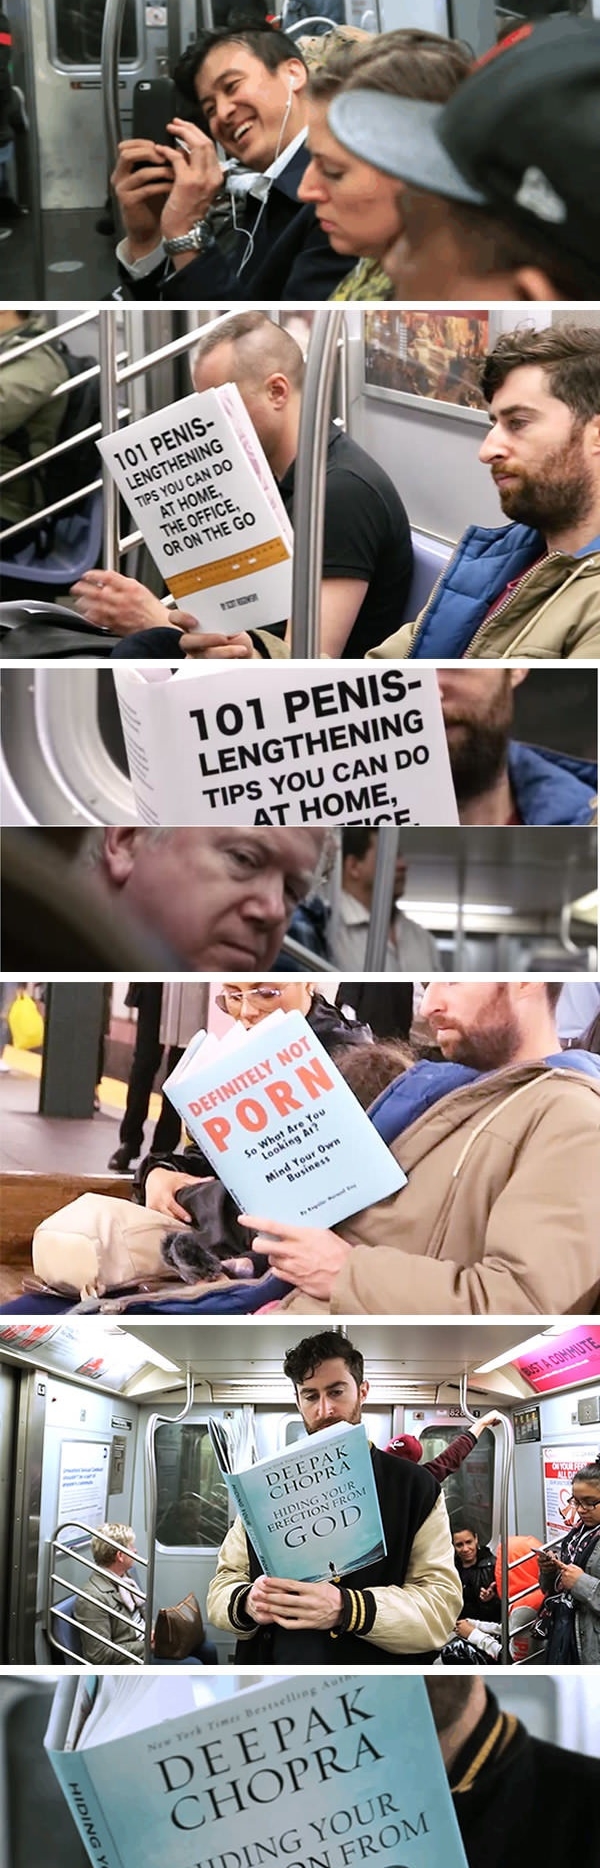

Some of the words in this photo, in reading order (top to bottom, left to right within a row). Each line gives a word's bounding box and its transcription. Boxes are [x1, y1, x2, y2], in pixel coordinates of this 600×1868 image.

[189, 697, 265, 741] 101
[283, 669, 422, 724] PENIS-
[198, 709, 424, 777] LENGTHENING
[202, 780, 263, 809] TIPS
[268, 767, 325, 796] YOU
[332, 753, 388, 783] CAN
[394, 744, 430, 770] DO
[253, 803, 291, 826] AT
[300, 782, 398, 822] HOME,
[187, 1060, 274, 1118] DEFINITELY
[276, 1035, 312, 1067] NOT
[202, 1056, 335, 1153] PORN
[520, 1362, 545, 1377] BUST
[544, 1358, 552, 1369] A
[553, 1337, 600, 1365] COMMUTE
[154, 1686, 377, 1794] DEEPAK
[169, 1732, 385, 1831] CHOPRA
[308, 1792, 401, 1843] YOUR
[338, 1811, 431, 1867] FROM
